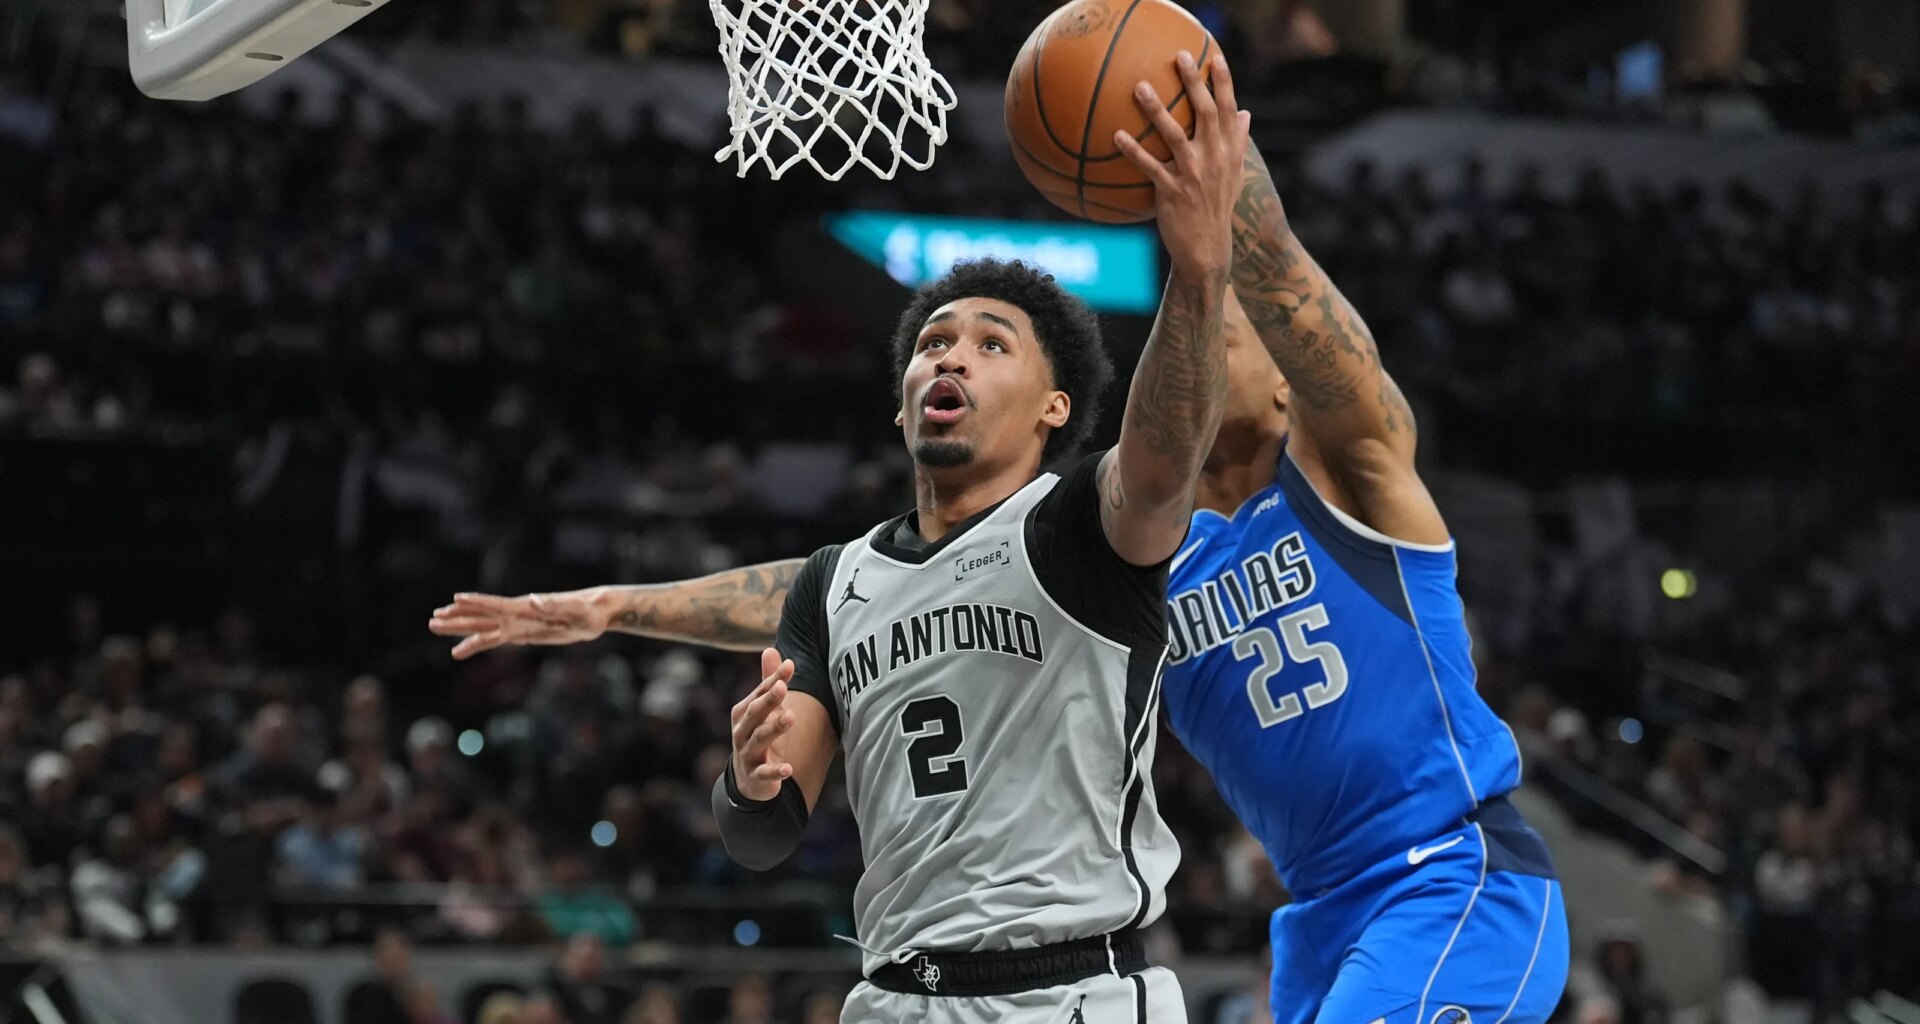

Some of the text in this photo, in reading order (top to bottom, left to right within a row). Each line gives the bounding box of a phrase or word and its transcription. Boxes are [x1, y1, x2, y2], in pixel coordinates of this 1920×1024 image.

[961, 550, 1002, 573] LEDGER
[836, 603, 1044, 719] SAN ANTONIO
[1232, 603, 1348, 729] 25
[898, 693, 970, 800] 2
